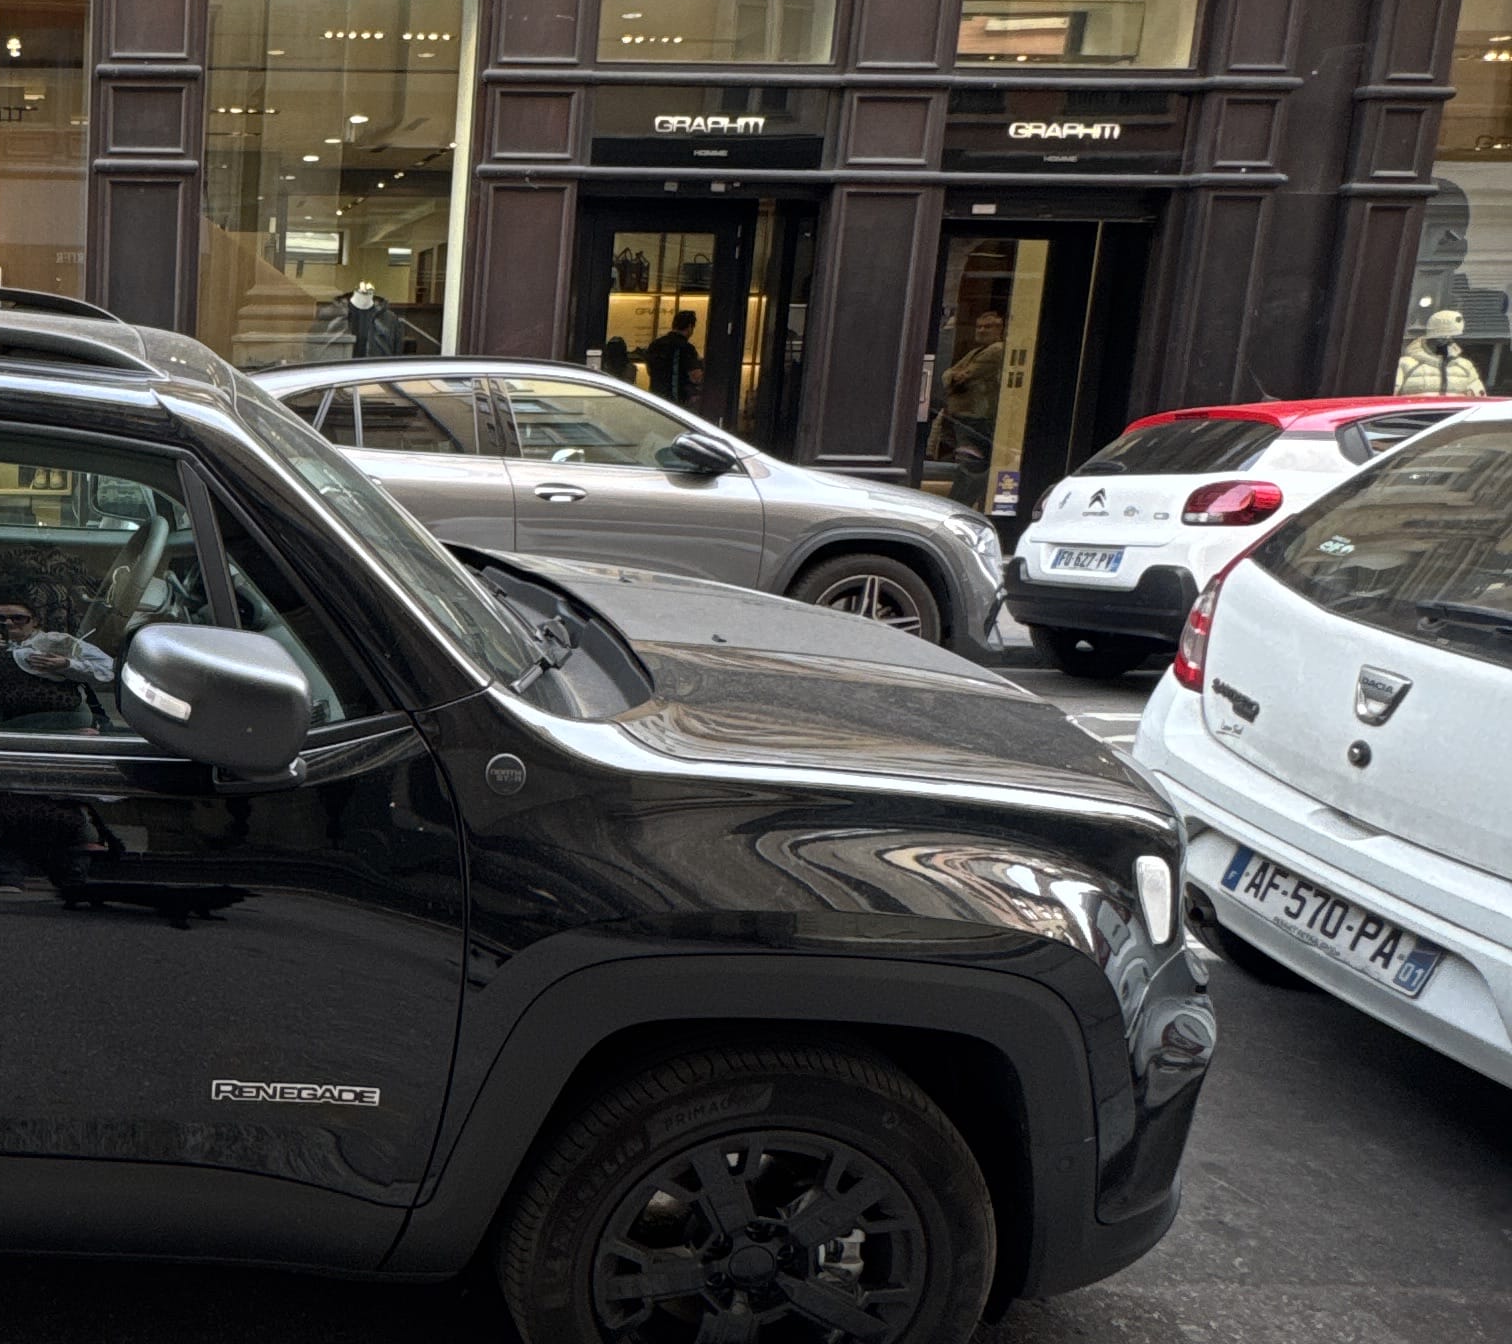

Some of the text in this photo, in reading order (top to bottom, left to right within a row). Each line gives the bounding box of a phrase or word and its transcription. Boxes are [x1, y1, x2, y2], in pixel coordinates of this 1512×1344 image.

[654, 116, 765, 134] GRAPHITI
[1008, 122, 1121, 139] GRAPHITI
[1361, 676, 1394, 694] DACIA
[1244, 861, 1404, 970] AF-570-PA
[1398, 962, 1425, 987] 01
[211, 1080, 380, 1106] RENEGADE
